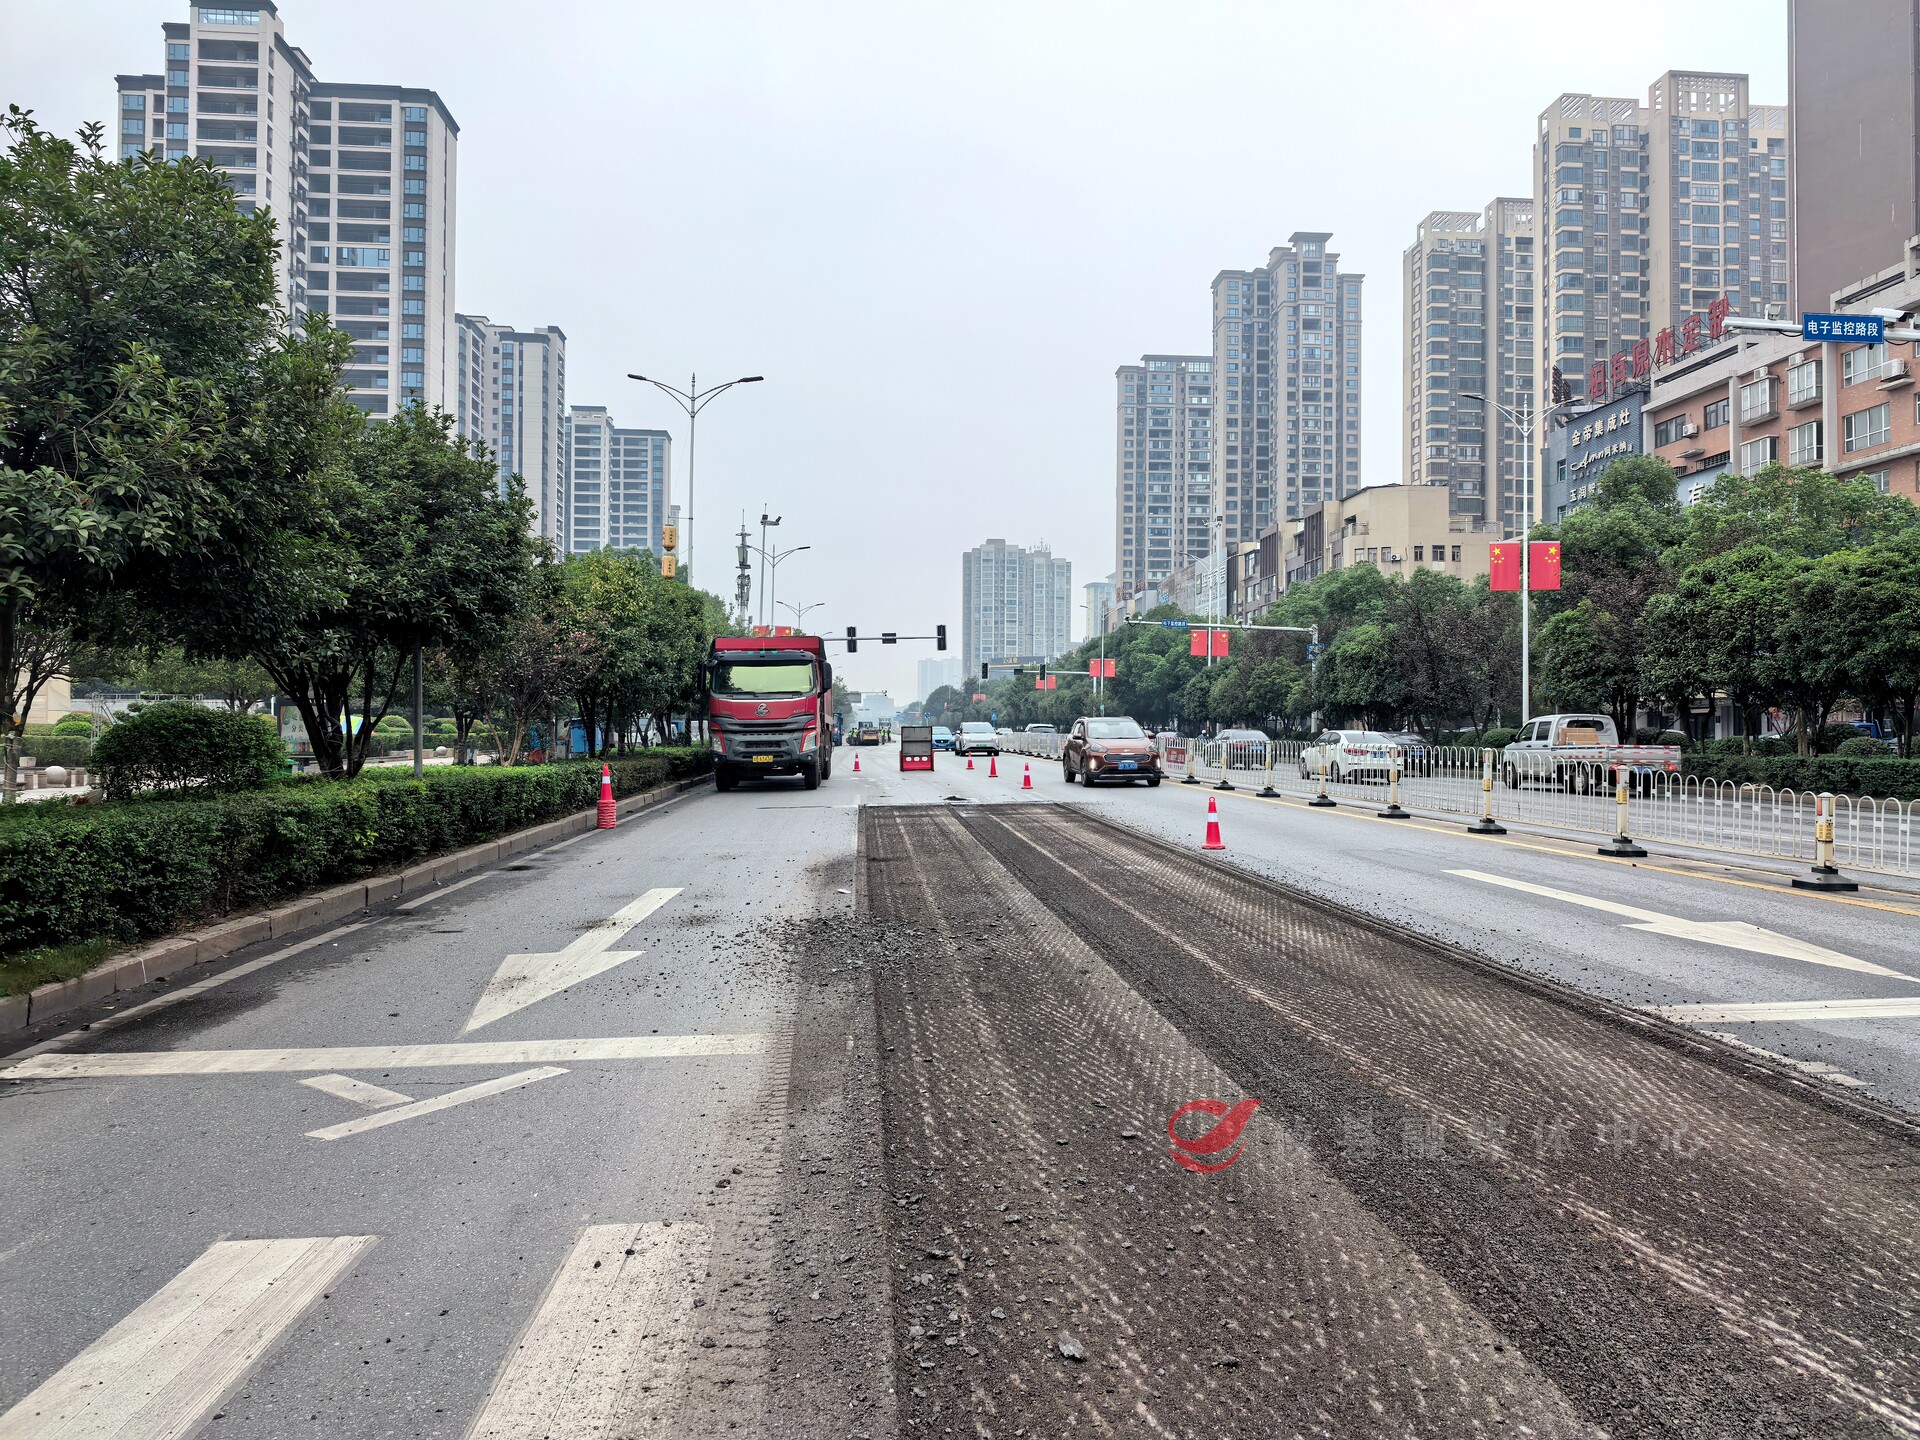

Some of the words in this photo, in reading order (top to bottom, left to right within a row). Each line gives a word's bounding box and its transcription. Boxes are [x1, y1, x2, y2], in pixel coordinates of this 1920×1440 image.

[1807, 320, 1879, 337] 电子监控路段
[1571, 407, 1631, 448] 金帝集成灶
